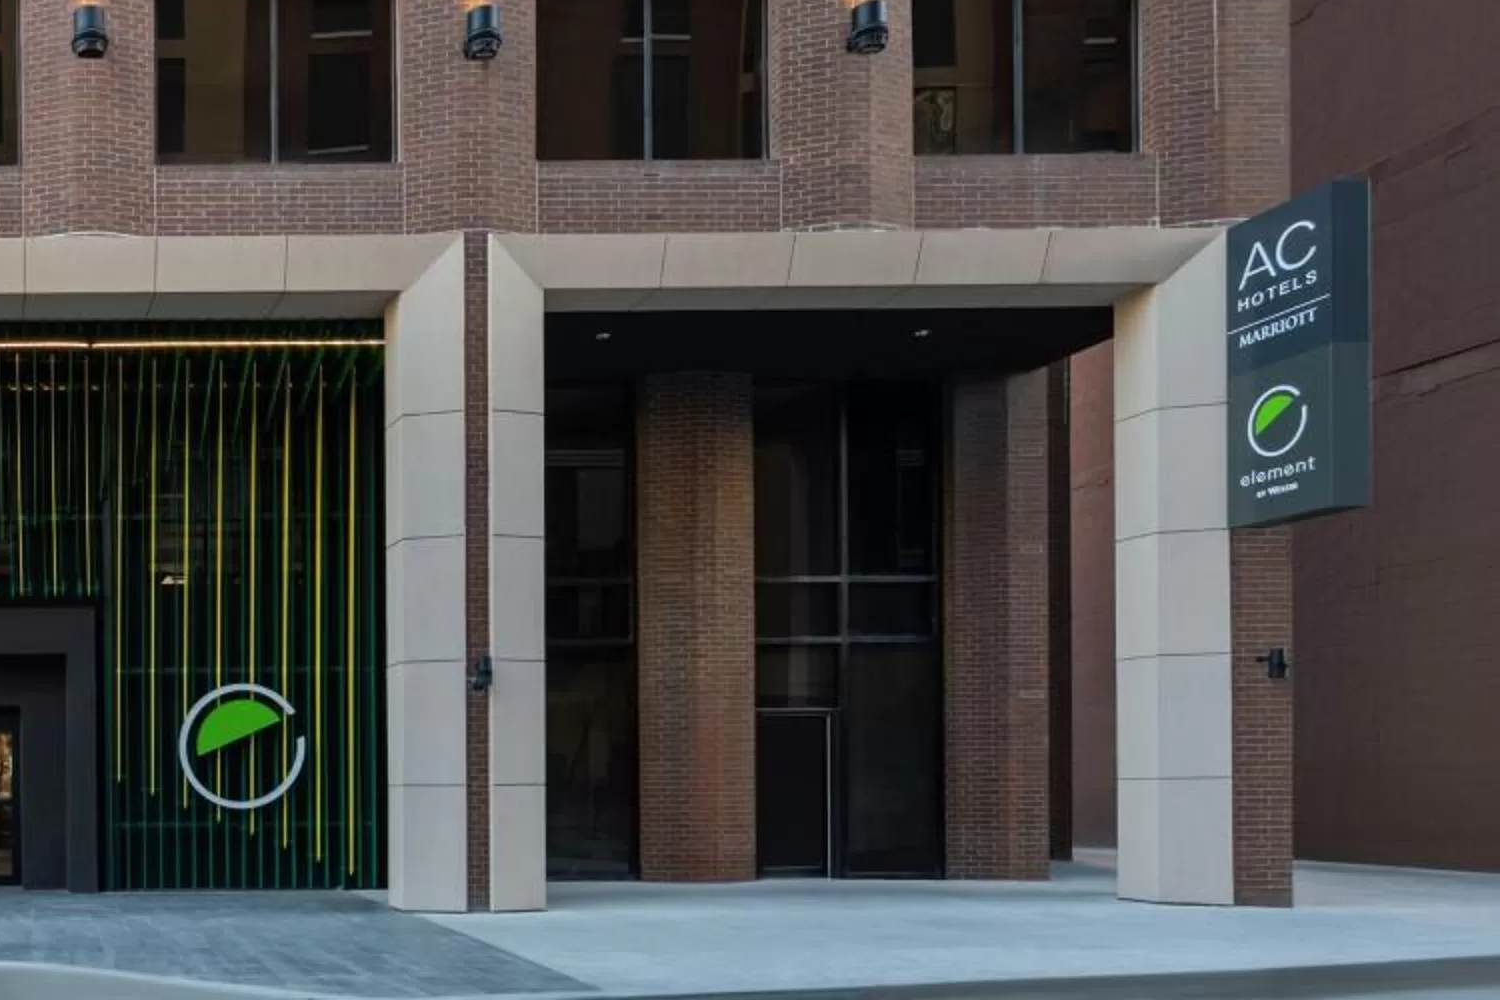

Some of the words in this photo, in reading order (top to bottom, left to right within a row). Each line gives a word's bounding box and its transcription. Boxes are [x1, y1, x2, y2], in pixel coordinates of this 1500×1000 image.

[1238, 219, 1317, 292] AC
[1237, 269, 1318, 313] HOTELS
[1238, 306, 1318, 349] MARRIOTT
[1239, 455, 1317, 488] element
